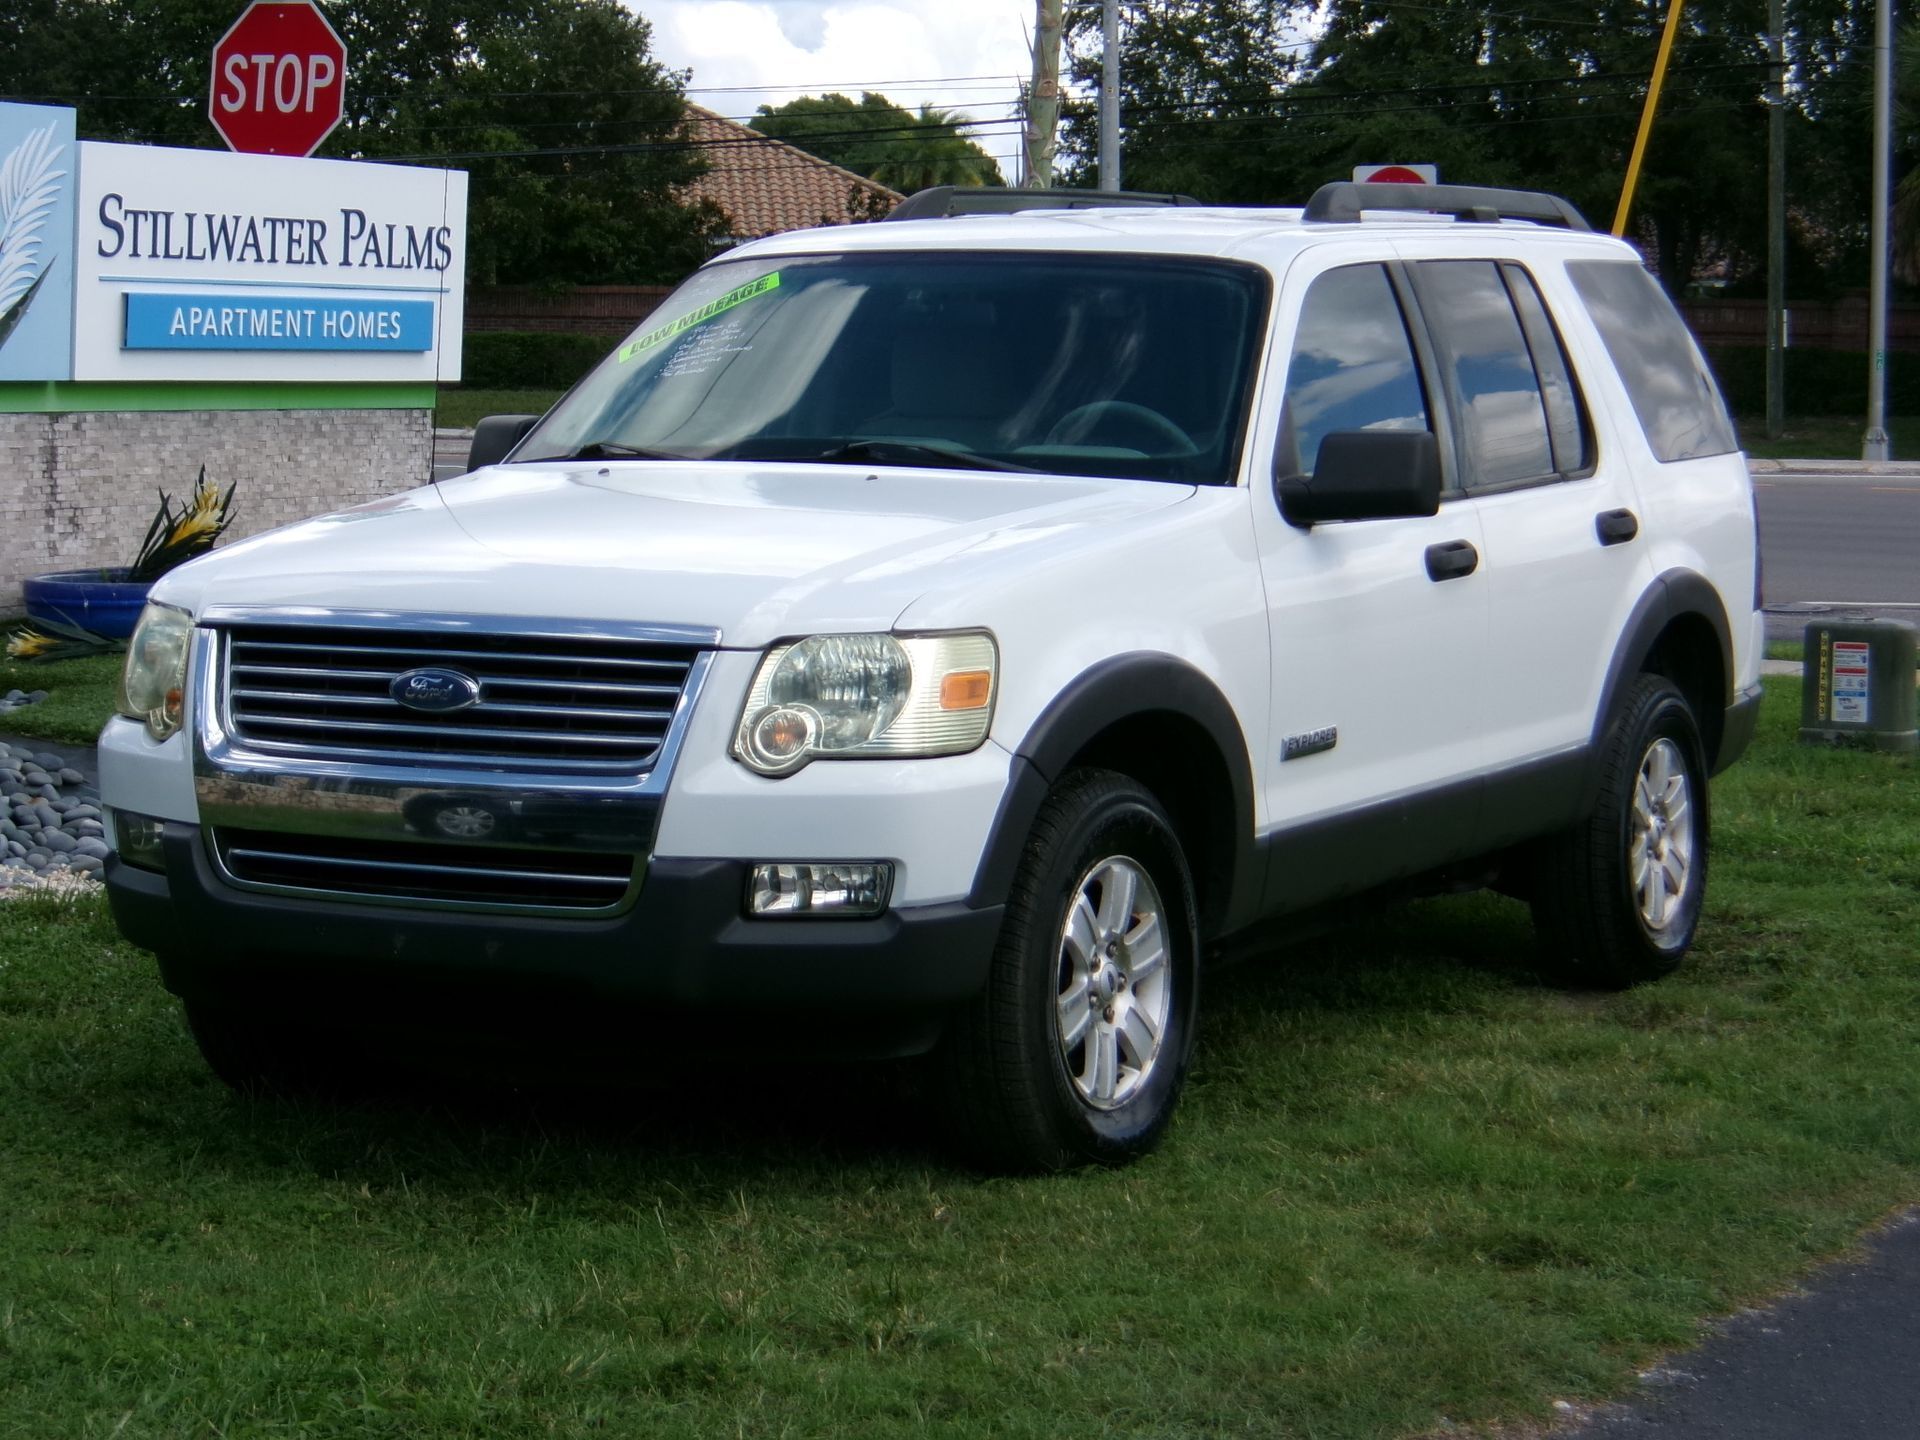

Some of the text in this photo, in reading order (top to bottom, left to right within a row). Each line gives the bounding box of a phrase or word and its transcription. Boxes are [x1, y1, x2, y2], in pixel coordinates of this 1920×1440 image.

[220, 53, 336, 113] STOP
[98, 192, 452, 272] STILLWATER PALMS
[169, 307, 401, 339] APARTMENT HOMES
[629, 324, 674, 355] LOW
[405, 675, 454, 699] Ford
